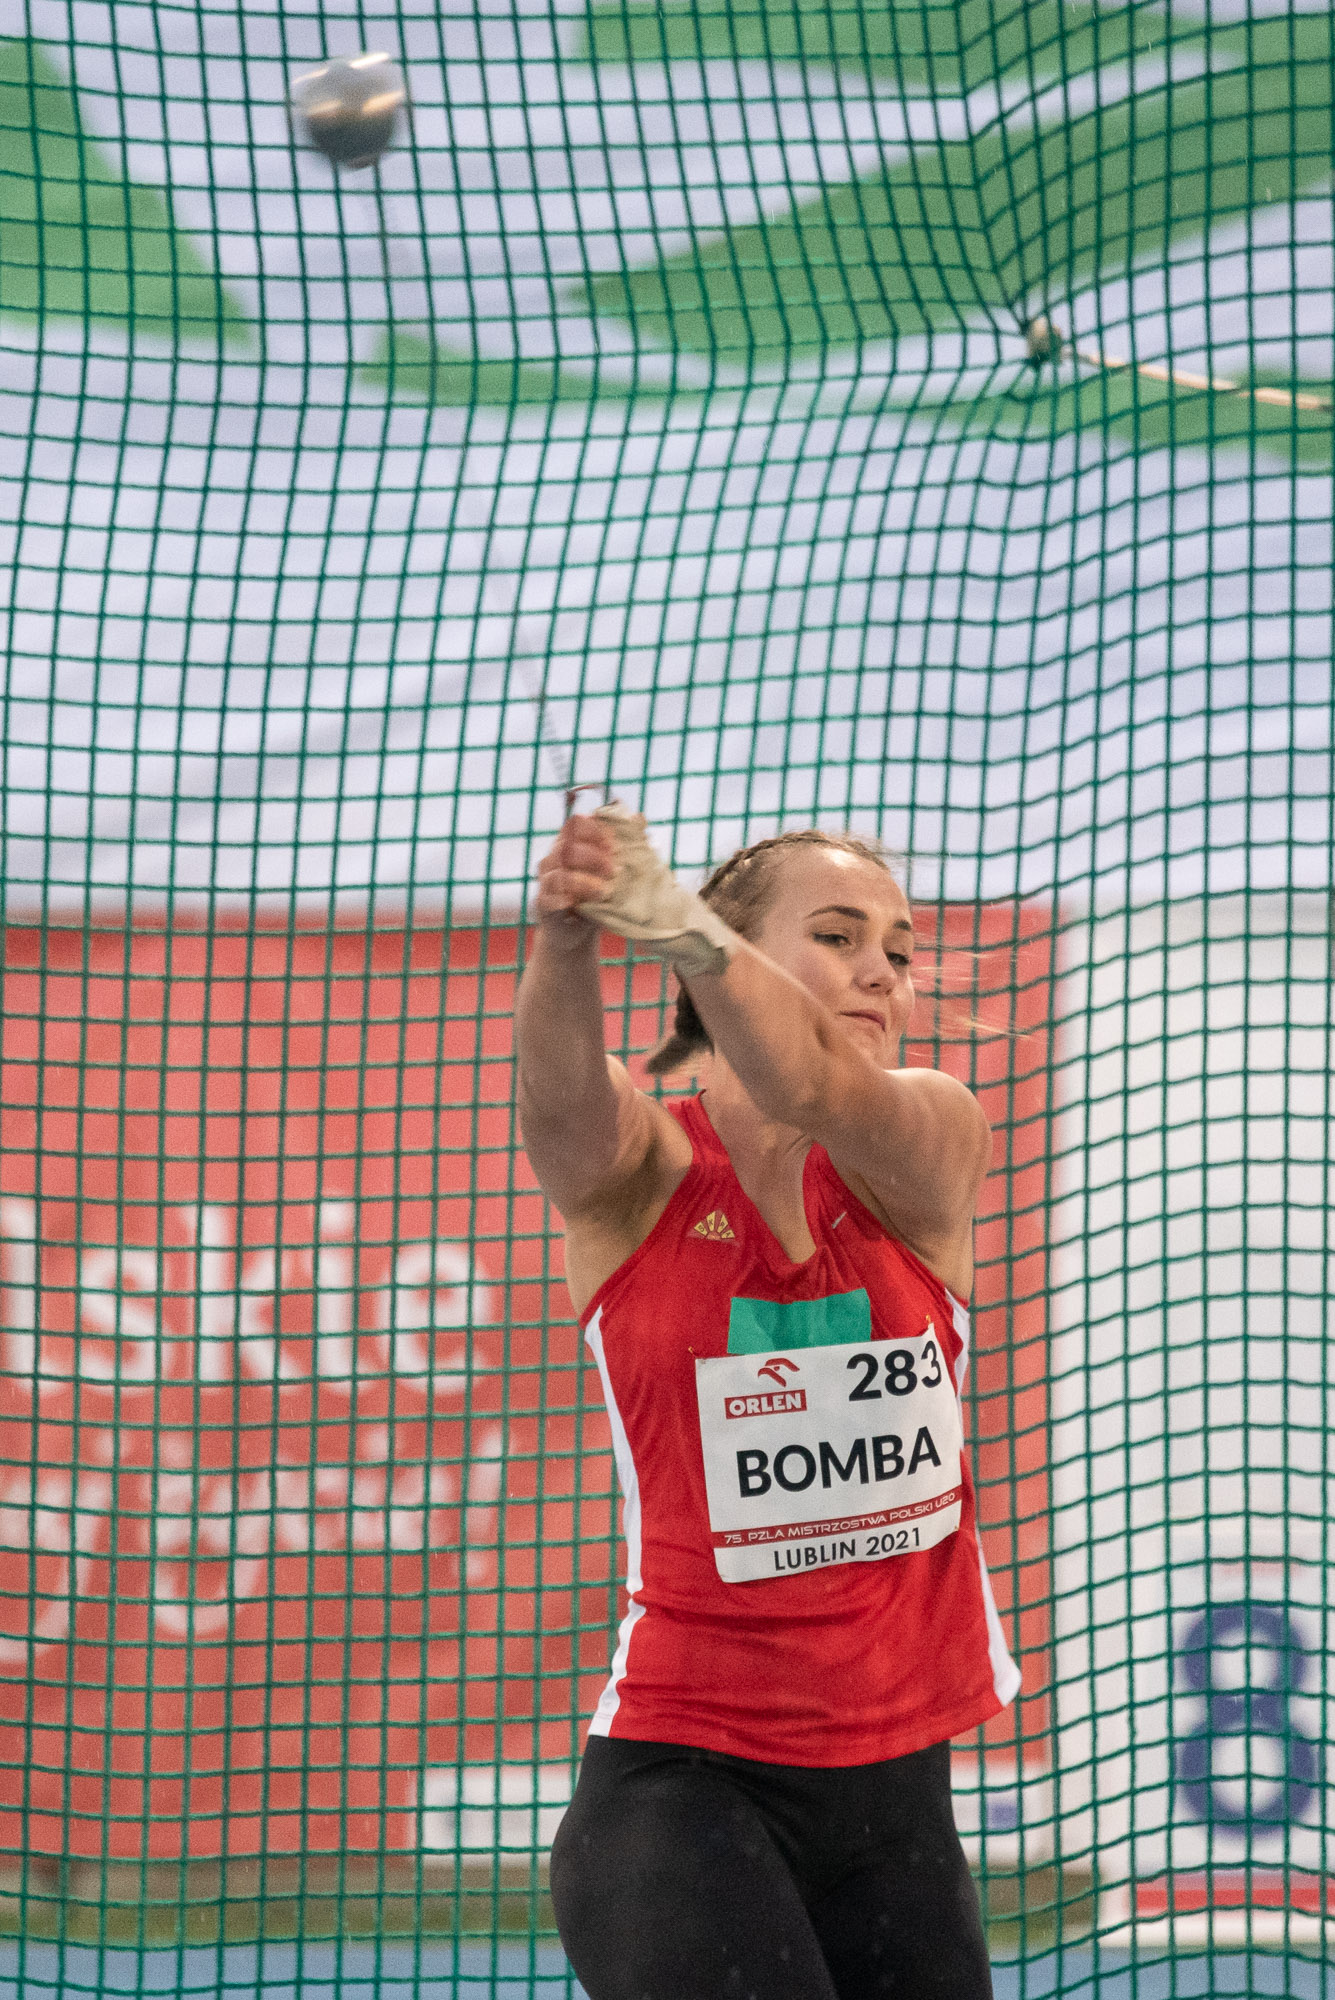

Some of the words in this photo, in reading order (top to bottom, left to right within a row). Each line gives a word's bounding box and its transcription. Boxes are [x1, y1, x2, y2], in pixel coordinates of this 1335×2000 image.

[846, 1340, 942, 1402] 283
[728, 1391, 803, 1417] ORLEN
[736, 1426, 942, 1498] BOMBA
[724, 1535, 746, 1545] 75.
[748, 1528, 786, 1541] PZLA
[787, 1515, 887, 1538] MISTRZOSTWA
[889, 1503, 933, 1521] POLSKI
[935, 1492, 956, 1508] U20
[773, 1539, 856, 1571] LUBLIN
[865, 1527, 921, 1556] 2021
